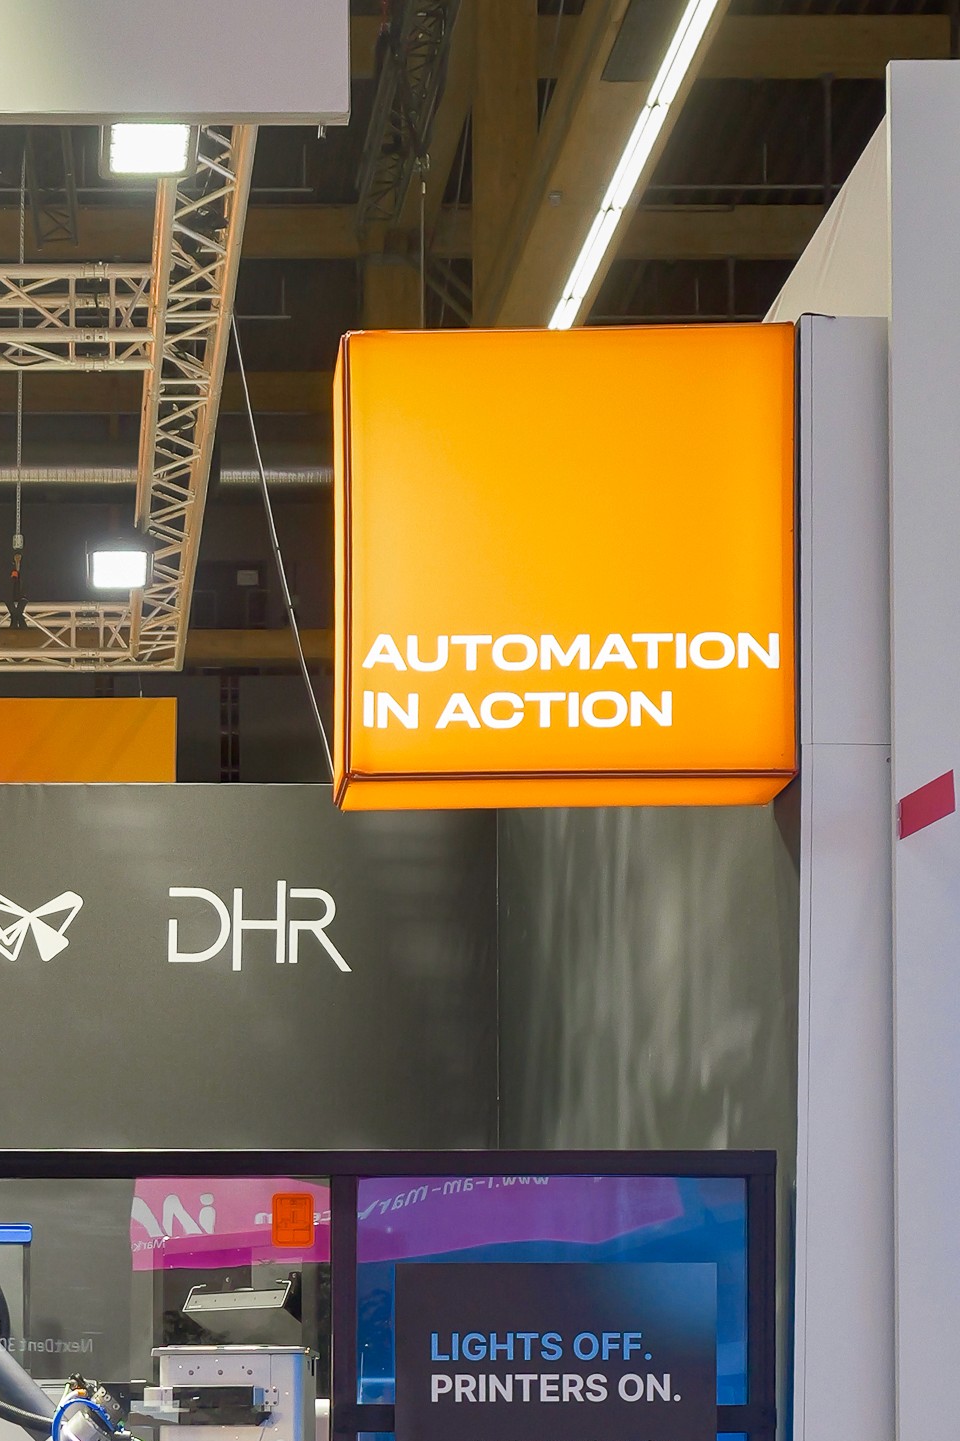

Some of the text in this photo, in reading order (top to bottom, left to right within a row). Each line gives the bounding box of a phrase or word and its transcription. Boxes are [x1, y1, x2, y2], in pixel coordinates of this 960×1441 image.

[362, 632, 780, 672] AUTOMATION
[363, 691, 673, 729] IN ACTION
[167, 880, 352, 973] DHR
[431, 1332, 653, 1361] LIGHTS OFF.
[431, 1373, 682, 1403] PRINTERS ON.
